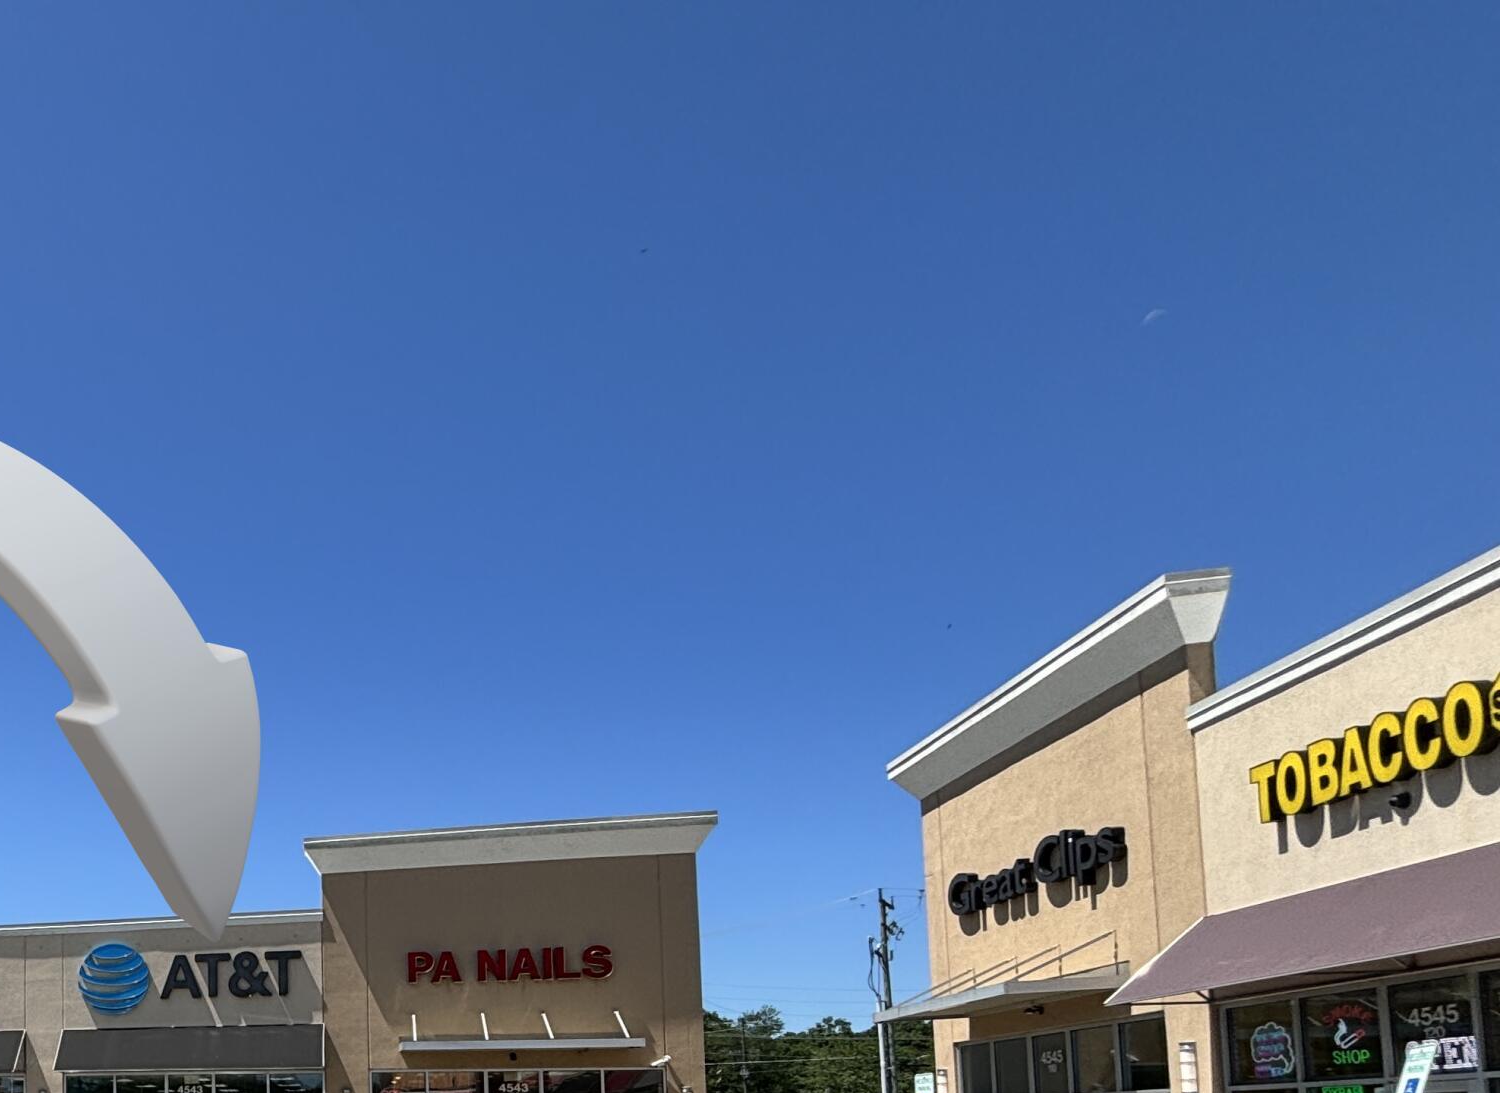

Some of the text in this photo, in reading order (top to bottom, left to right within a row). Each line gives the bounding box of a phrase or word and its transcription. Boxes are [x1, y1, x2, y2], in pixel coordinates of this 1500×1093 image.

[1249, 680, 1485, 824] TOBACCO
[948, 827, 1127, 915] Great Clips
[160, 950, 302, 999] AT&T
[407, 945, 613, 984] PA NAILS
[1407, 1003, 1460, 1027] 4545
[1040, 1050, 1063, 1063] 4545
[1332, 1050, 1370, 1064] SHOP
[177, 1085, 203, 1093] 4543
[498, 1083, 528, 1093] 4543
